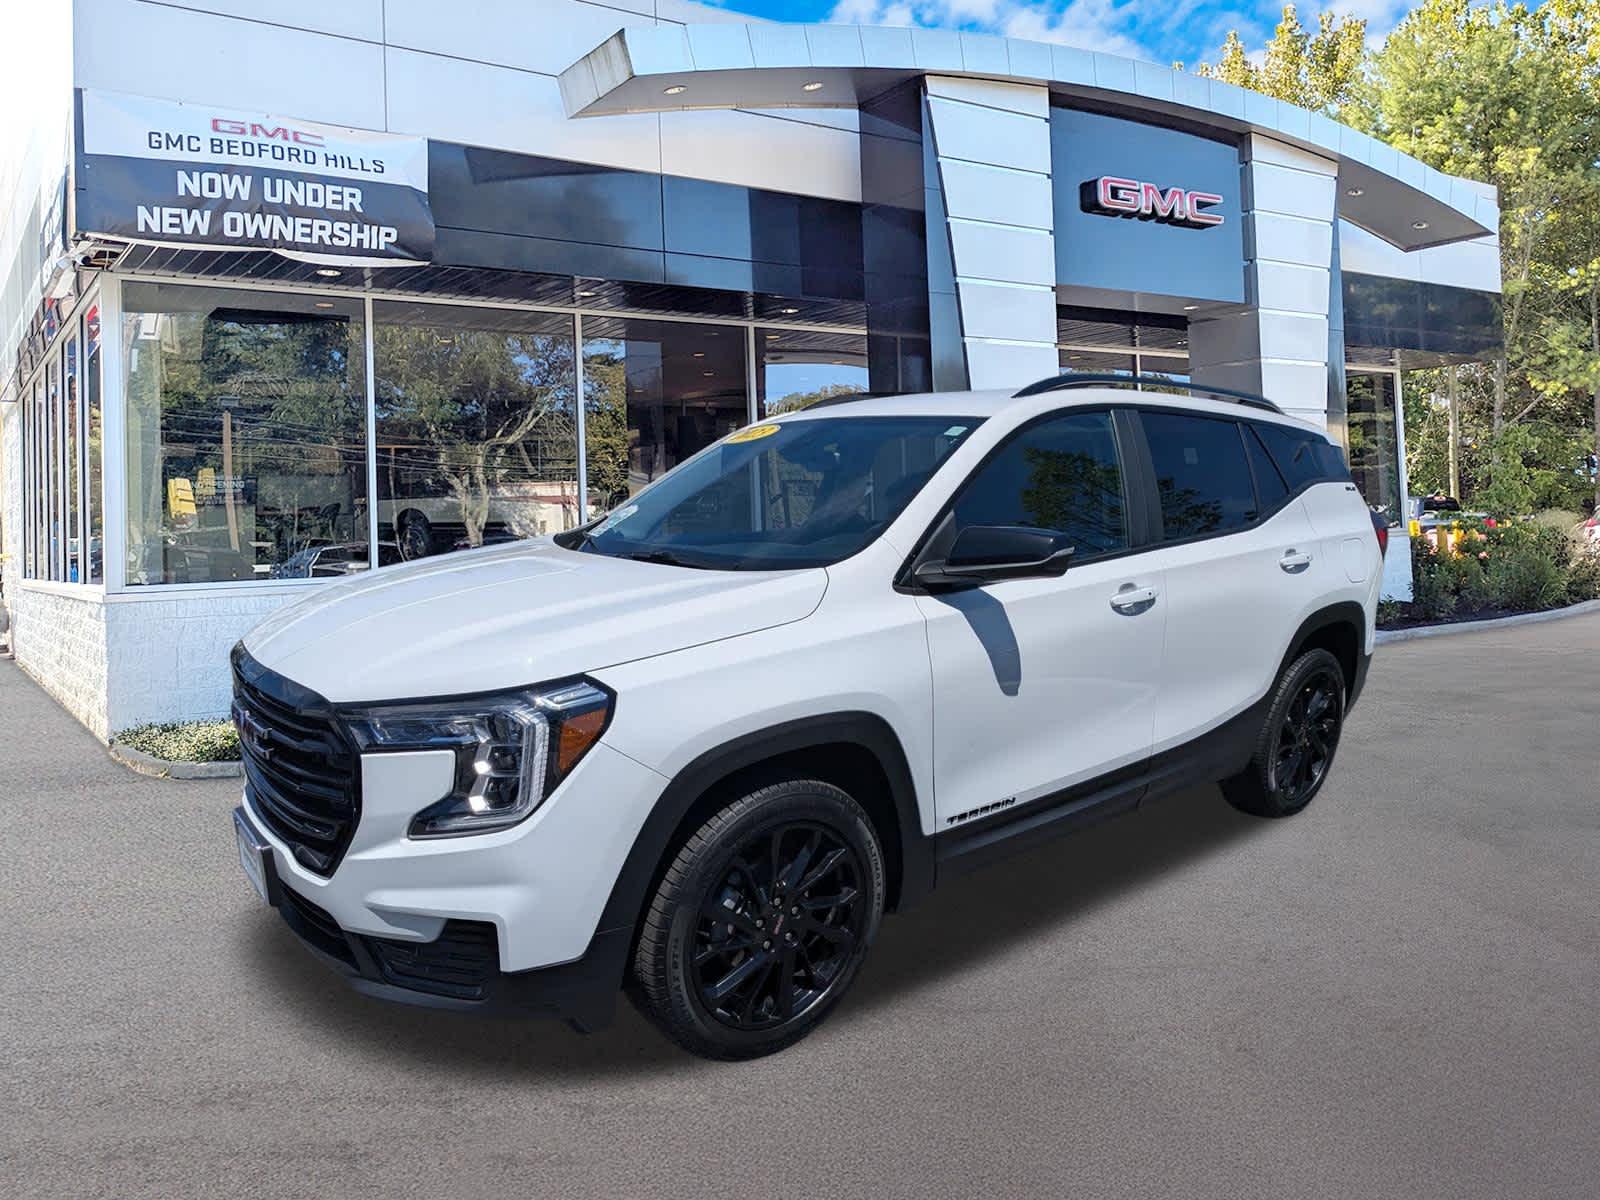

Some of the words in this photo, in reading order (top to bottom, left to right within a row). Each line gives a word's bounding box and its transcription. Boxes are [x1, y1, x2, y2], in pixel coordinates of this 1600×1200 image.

[148, 131, 201, 153] GMC
[210, 138, 316, 165] BEDFORD
[324, 153, 385, 174] HILLS
[211, 118, 325, 147] GMC
[177, 170, 253, 201] NOW
[264, 177, 364, 213] UNDER
[1097, 175, 1225, 225] GMC
[136, 205, 211, 236] NEW
[223, 211, 398, 250] OWNERSHIP
[946, 797, 1016, 825] TERRAIN
